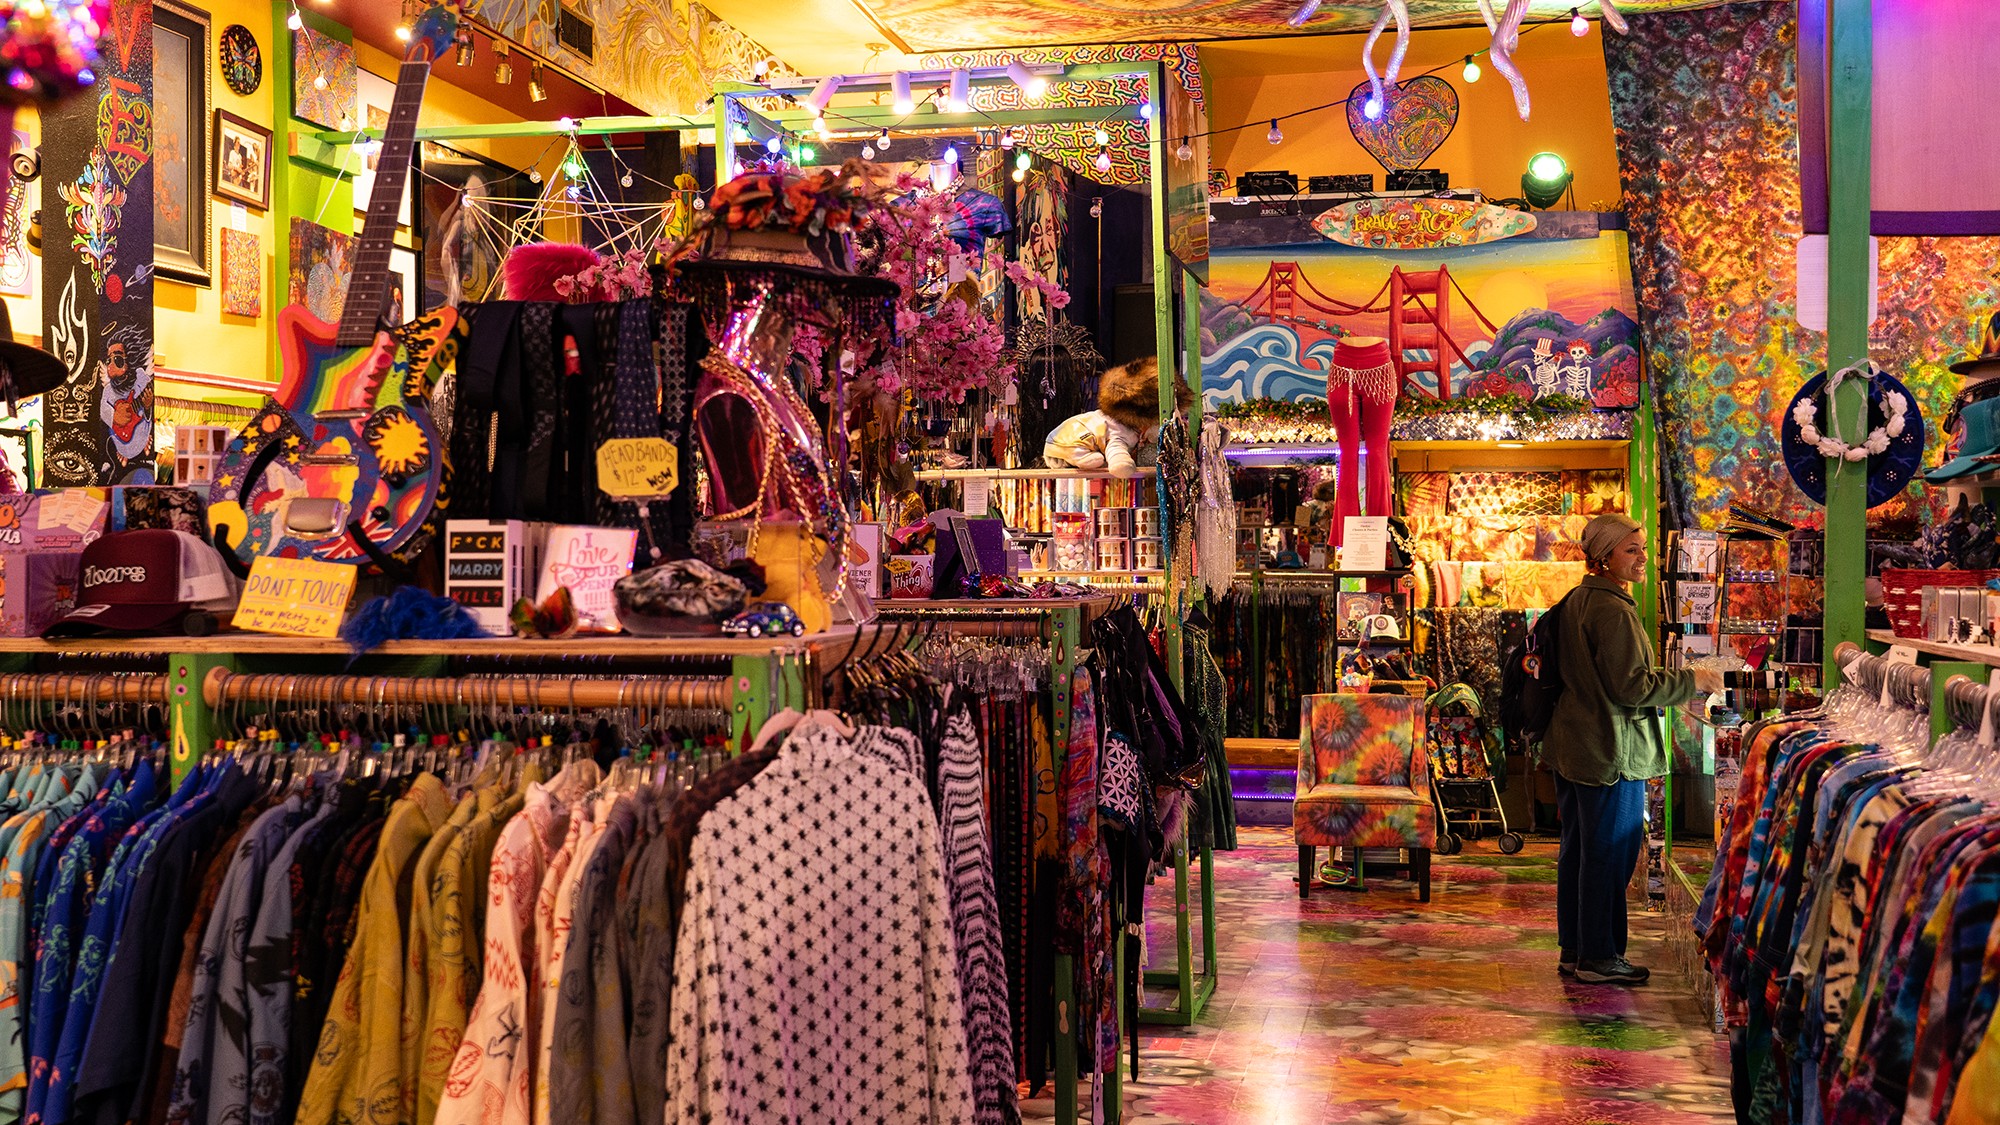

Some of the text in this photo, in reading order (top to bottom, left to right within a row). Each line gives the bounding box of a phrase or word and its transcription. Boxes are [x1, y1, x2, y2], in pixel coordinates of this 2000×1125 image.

[646, 467, 673, 487] WOW
[585, 532, 593, 548] I
[568, 537, 618, 565] Love
[450, 563, 502, 576] MARRY
[573, 564, 620, 579] YOUR
[579, 579, 617, 591] PENI
[895, 576, 921, 588] Thing
[301, 579, 349, 607] TOUCH
[451, 591, 503, 604] KILL?
